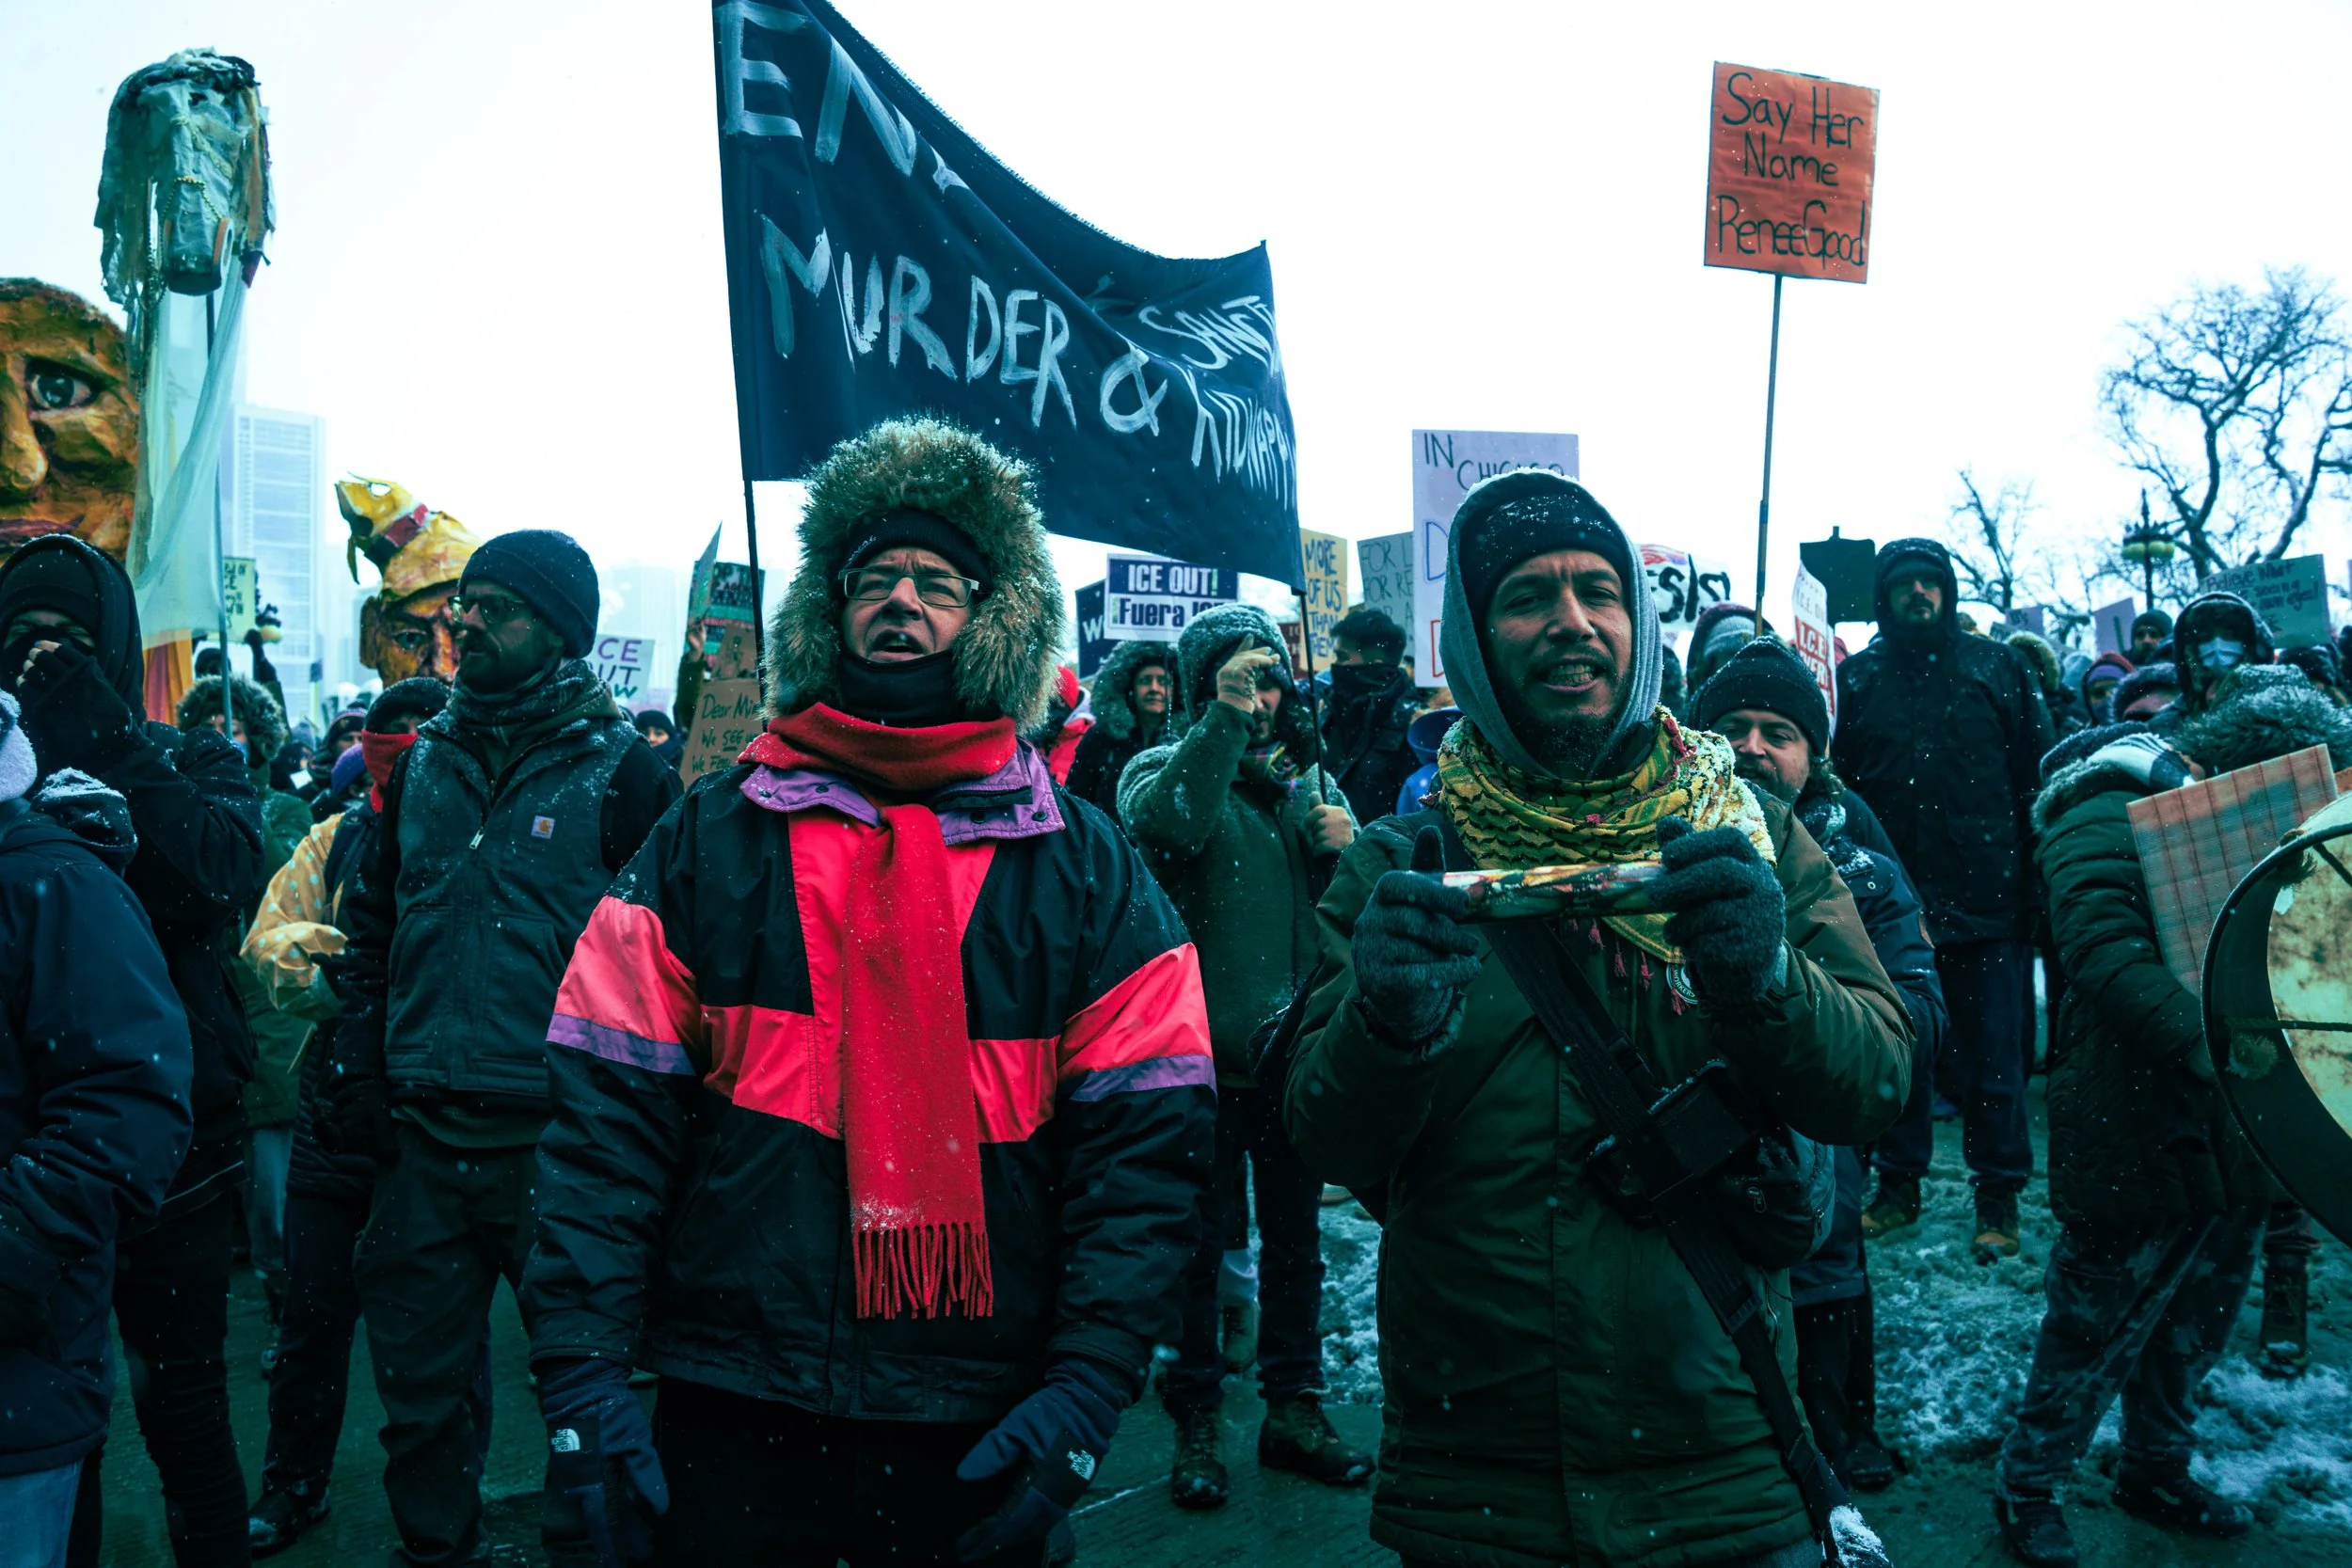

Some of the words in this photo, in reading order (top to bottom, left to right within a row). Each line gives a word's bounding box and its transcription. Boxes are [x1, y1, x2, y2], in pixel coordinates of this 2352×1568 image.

[1722, 72, 1794, 144] Say
[1812, 87, 1864, 149] Her
[1743, 132, 1839, 186] Name
[755, 214, 1077, 429] MURDER
[1100, 341, 1168, 436] &
[1423, 433, 1454, 468] IN
[1305, 538, 1338, 577] MORE
[1360, 541, 1396, 573] FOR
[1128, 563, 1163, 593] ICE
[1168, 565, 1218, 596] OUT!
[1307, 577, 1322, 608] OF
[1325, 578, 1343, 612] US
[597, 637, 642, 664] CE
[588, 662, 642, 686] UT
[701, 693, 731, 721] Dear
[702, 729, 717, 749] We
[722, 729, 745, 747] SEE
